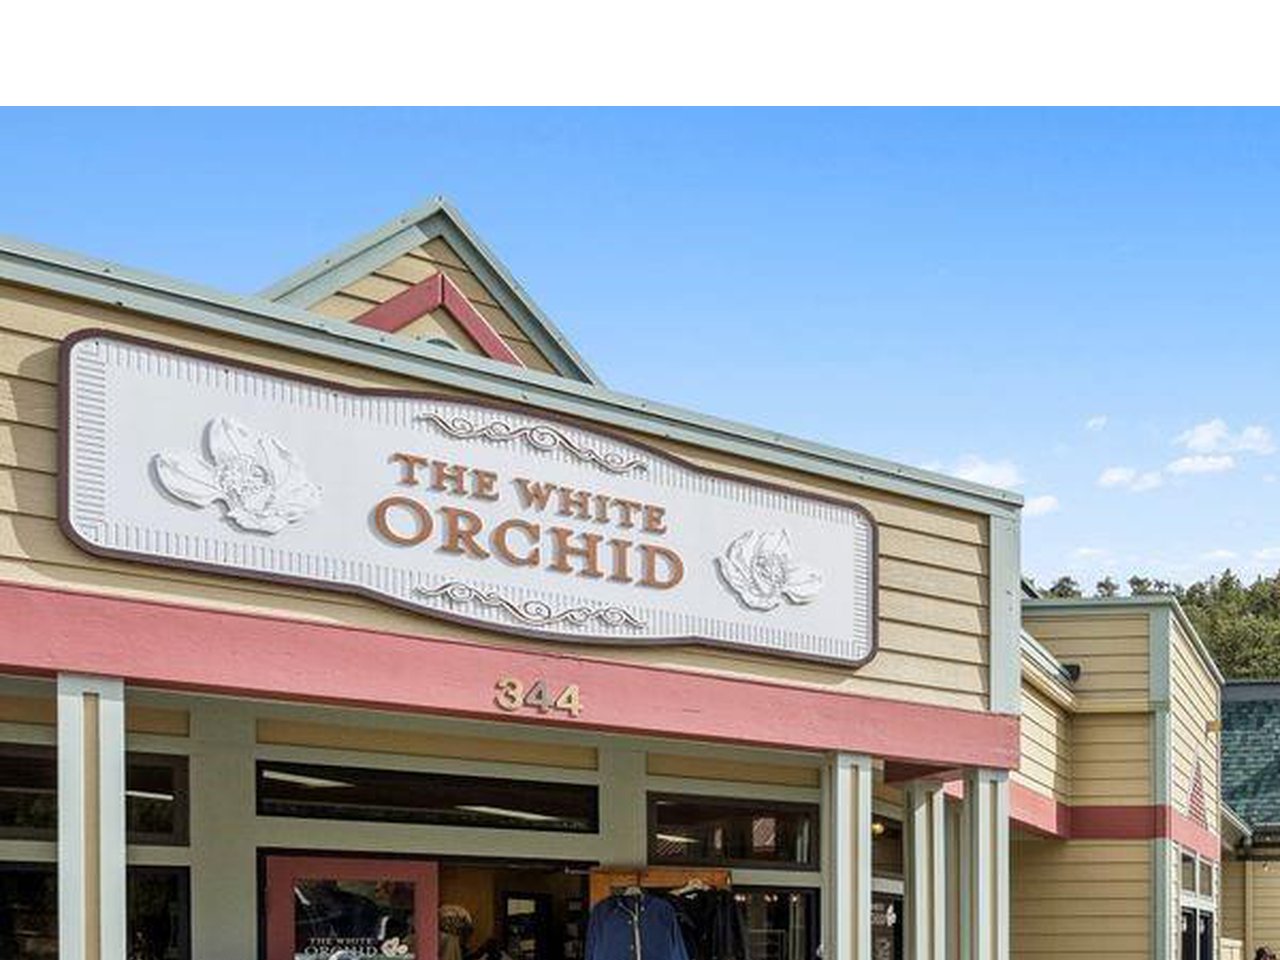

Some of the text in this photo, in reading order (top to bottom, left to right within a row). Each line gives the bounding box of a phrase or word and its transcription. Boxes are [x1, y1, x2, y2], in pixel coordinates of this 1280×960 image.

[388, 452, 667, 534] THE WHITE
[371, 496, 685, 590] ORCHID
[494, 676, 582, 717] 344
